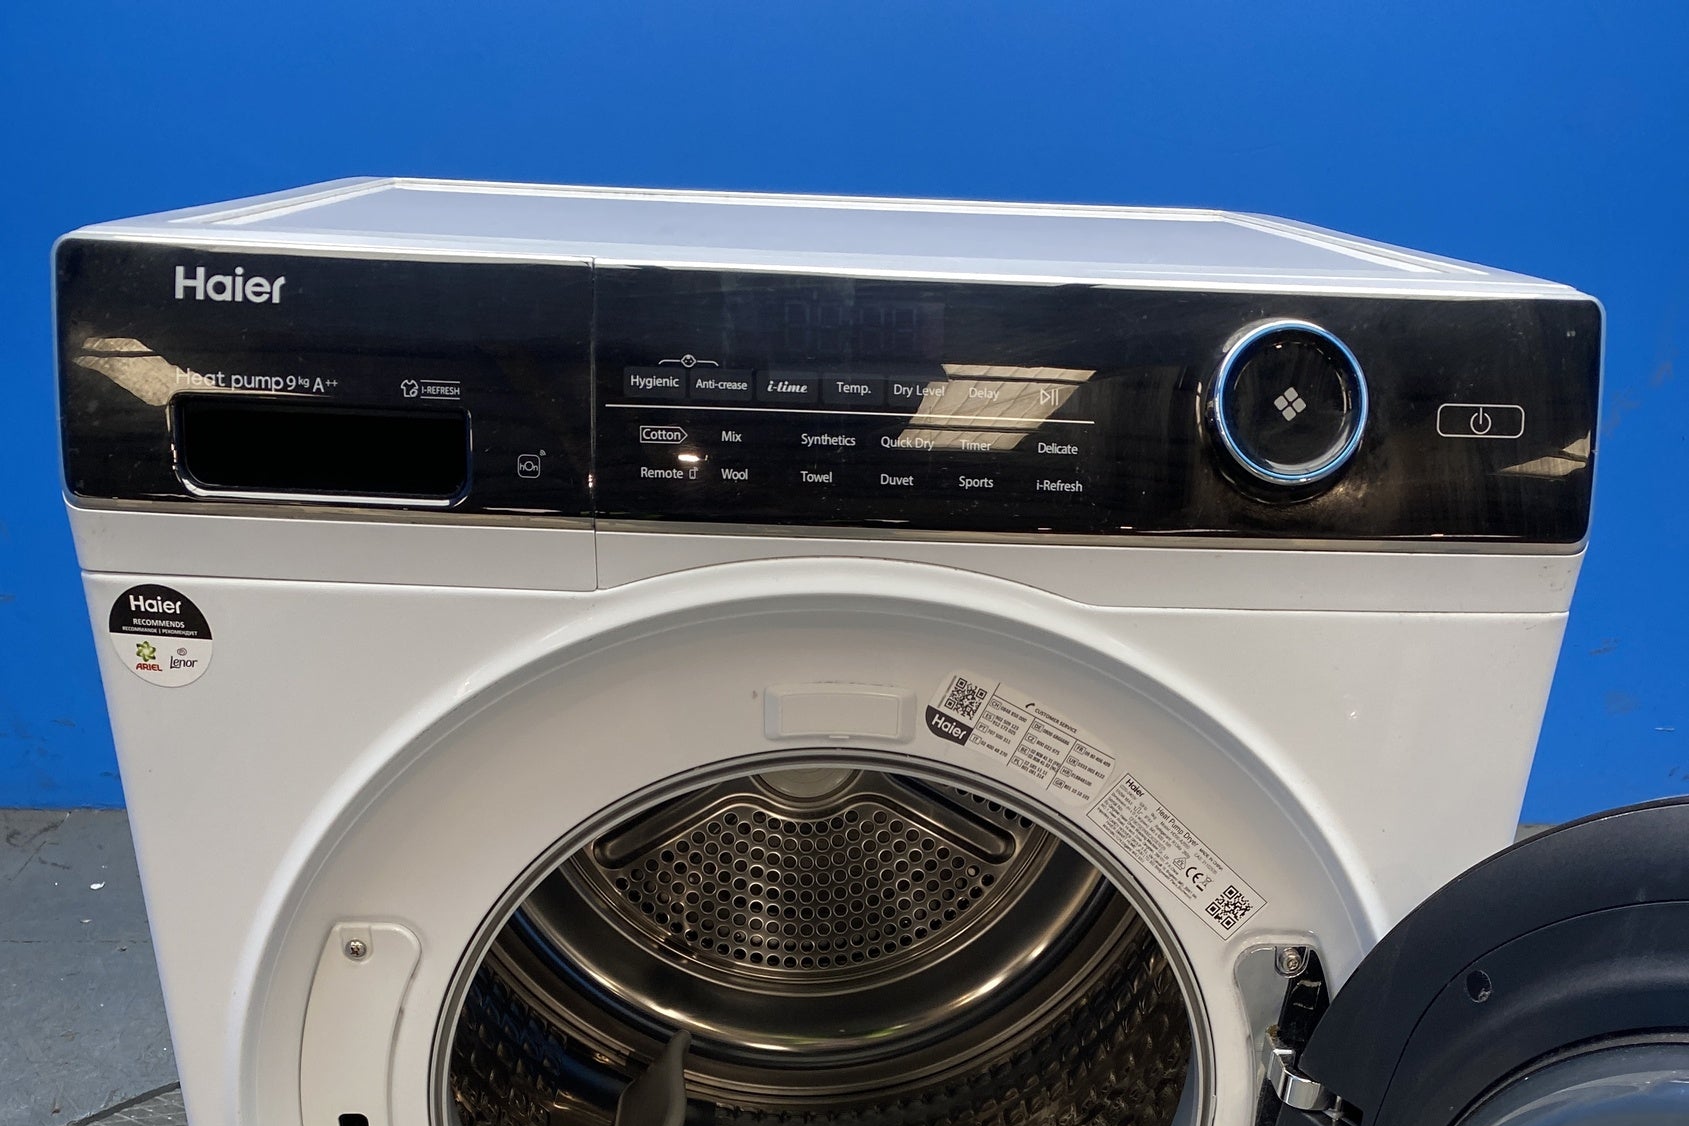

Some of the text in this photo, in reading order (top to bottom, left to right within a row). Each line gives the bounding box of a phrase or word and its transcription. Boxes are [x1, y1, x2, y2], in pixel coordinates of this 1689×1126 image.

[175, 266, 285, 303] Haier
[175, 368, 225, 387] Heat
[231, 374, 283, 392] pump
[630, 374, 679, 390] Hygienic
[695, 378, 747, 391] Anti-crease
[767, 380, 808, 394] i-time
[421, 385, 461, 396] I-REFRESH
[837, 381, 871, 396] Temp.
[893, 383, 945, 399] Dry Level
[968, 386, 999, 402] Delay
[643, 428, 681, 442] Cotton
[722, 430, 742, 443] Mix
[801, 433, 856, 449] Synthetics
[881, 435, 934, 451] Quick Dry
[960, 439, 991, 451] Timer
[1037, 441, 1078, 455] Delicate
[640, 467, 684, 480] Remote
[721, 468, 748, 481] Wool
[800, 471, 832, 483] Towel
[880, 473, 914, 486] Duvet
[958, 475, 994, 490] Sports
[1036, 479, 1083, 493] i-Refresh
[129, 594, 182, 614] Haier
[133, 618, 185, 629] RECOMMENDS
[136, 663, 163, 672] ARIEL
[170, 656, 198, 669] Lenor
[931, 713, 967, 740] Haier
[1034, 708, 1077, 734] CUSTOMER SERVICE
[1125, 778, 1145, 797] Haier
[1156, 806, 1199, 847] Heat Pump Dryer
